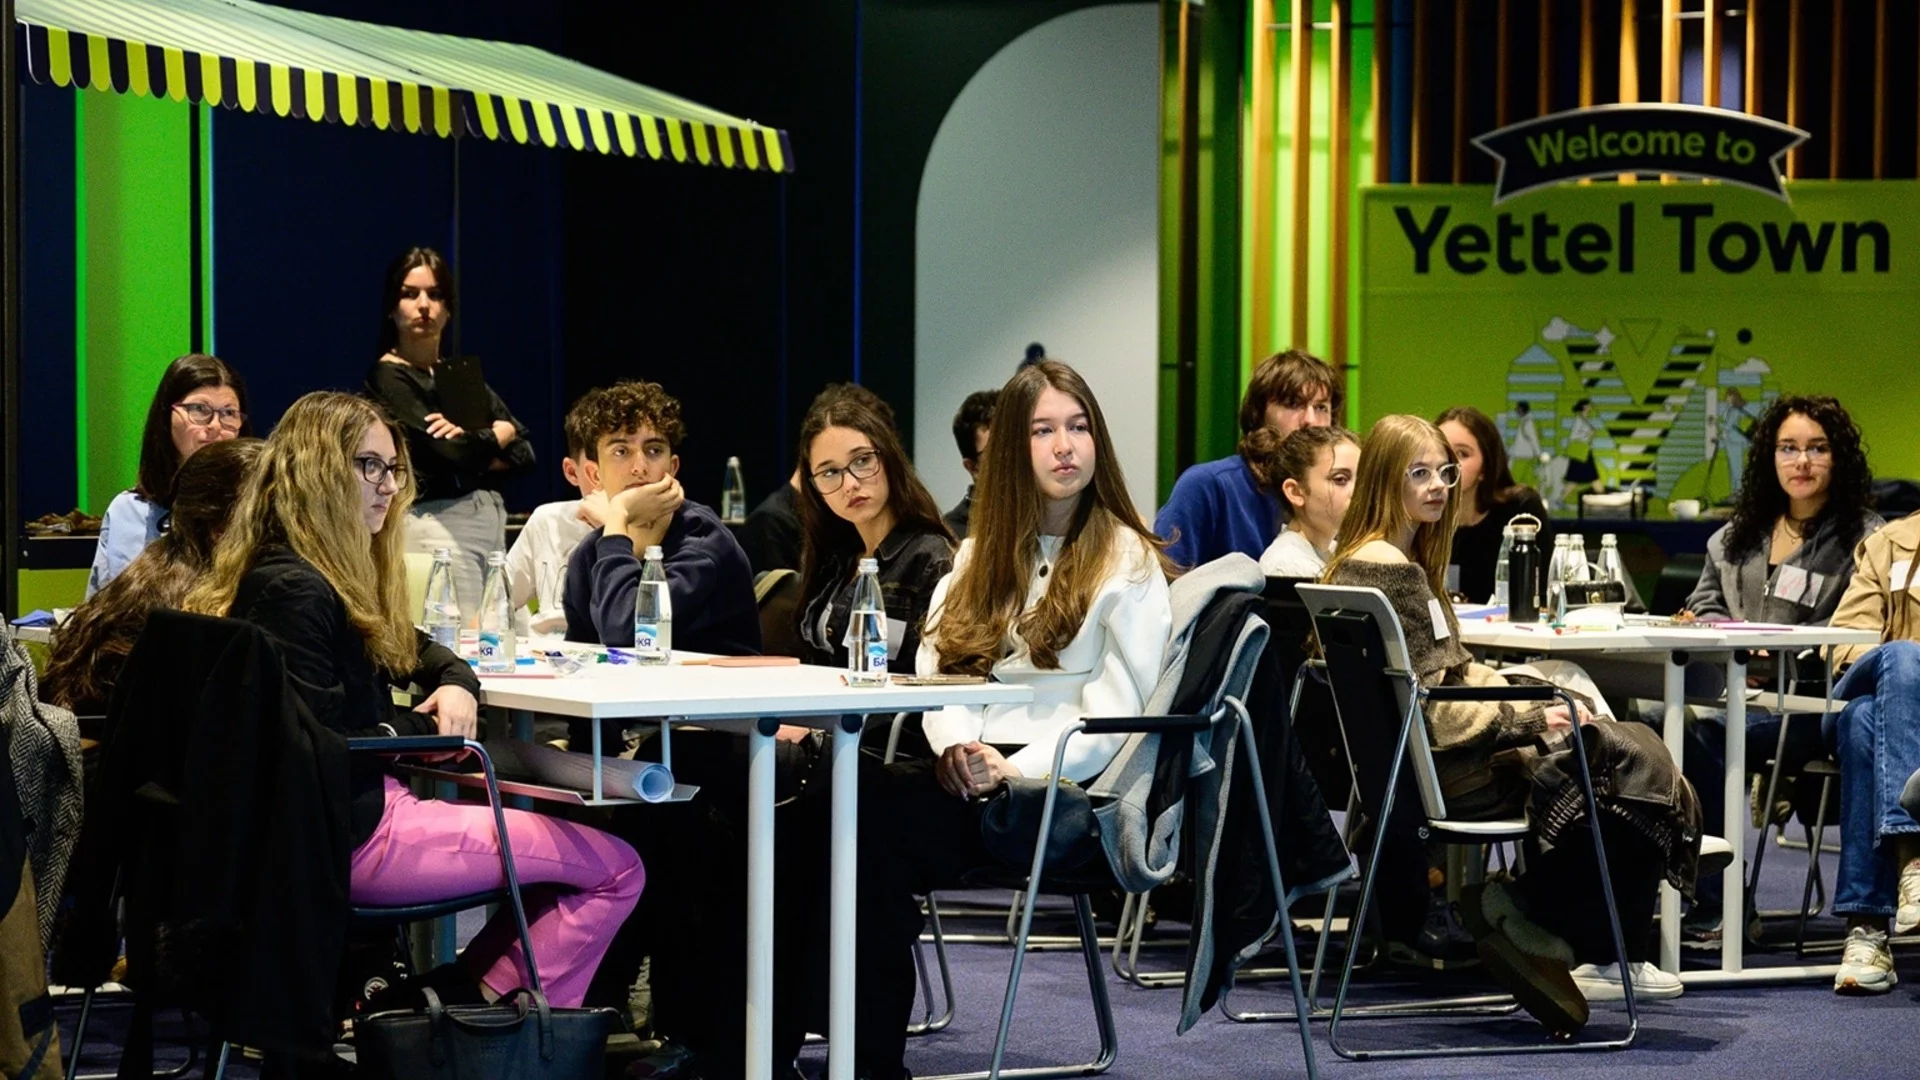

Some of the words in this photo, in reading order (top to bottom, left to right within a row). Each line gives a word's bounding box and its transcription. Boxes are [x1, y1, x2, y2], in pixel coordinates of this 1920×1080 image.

[1526, 125, 1706, 167] Welcome
[1715, 130, 1757, 165] to
[1393, 200, 1636, 276] Yettel
[1661, 201, 1891, 276] Town
[635, 637, 651, 647] КЯ
[873, 656, 887, 667] БА
